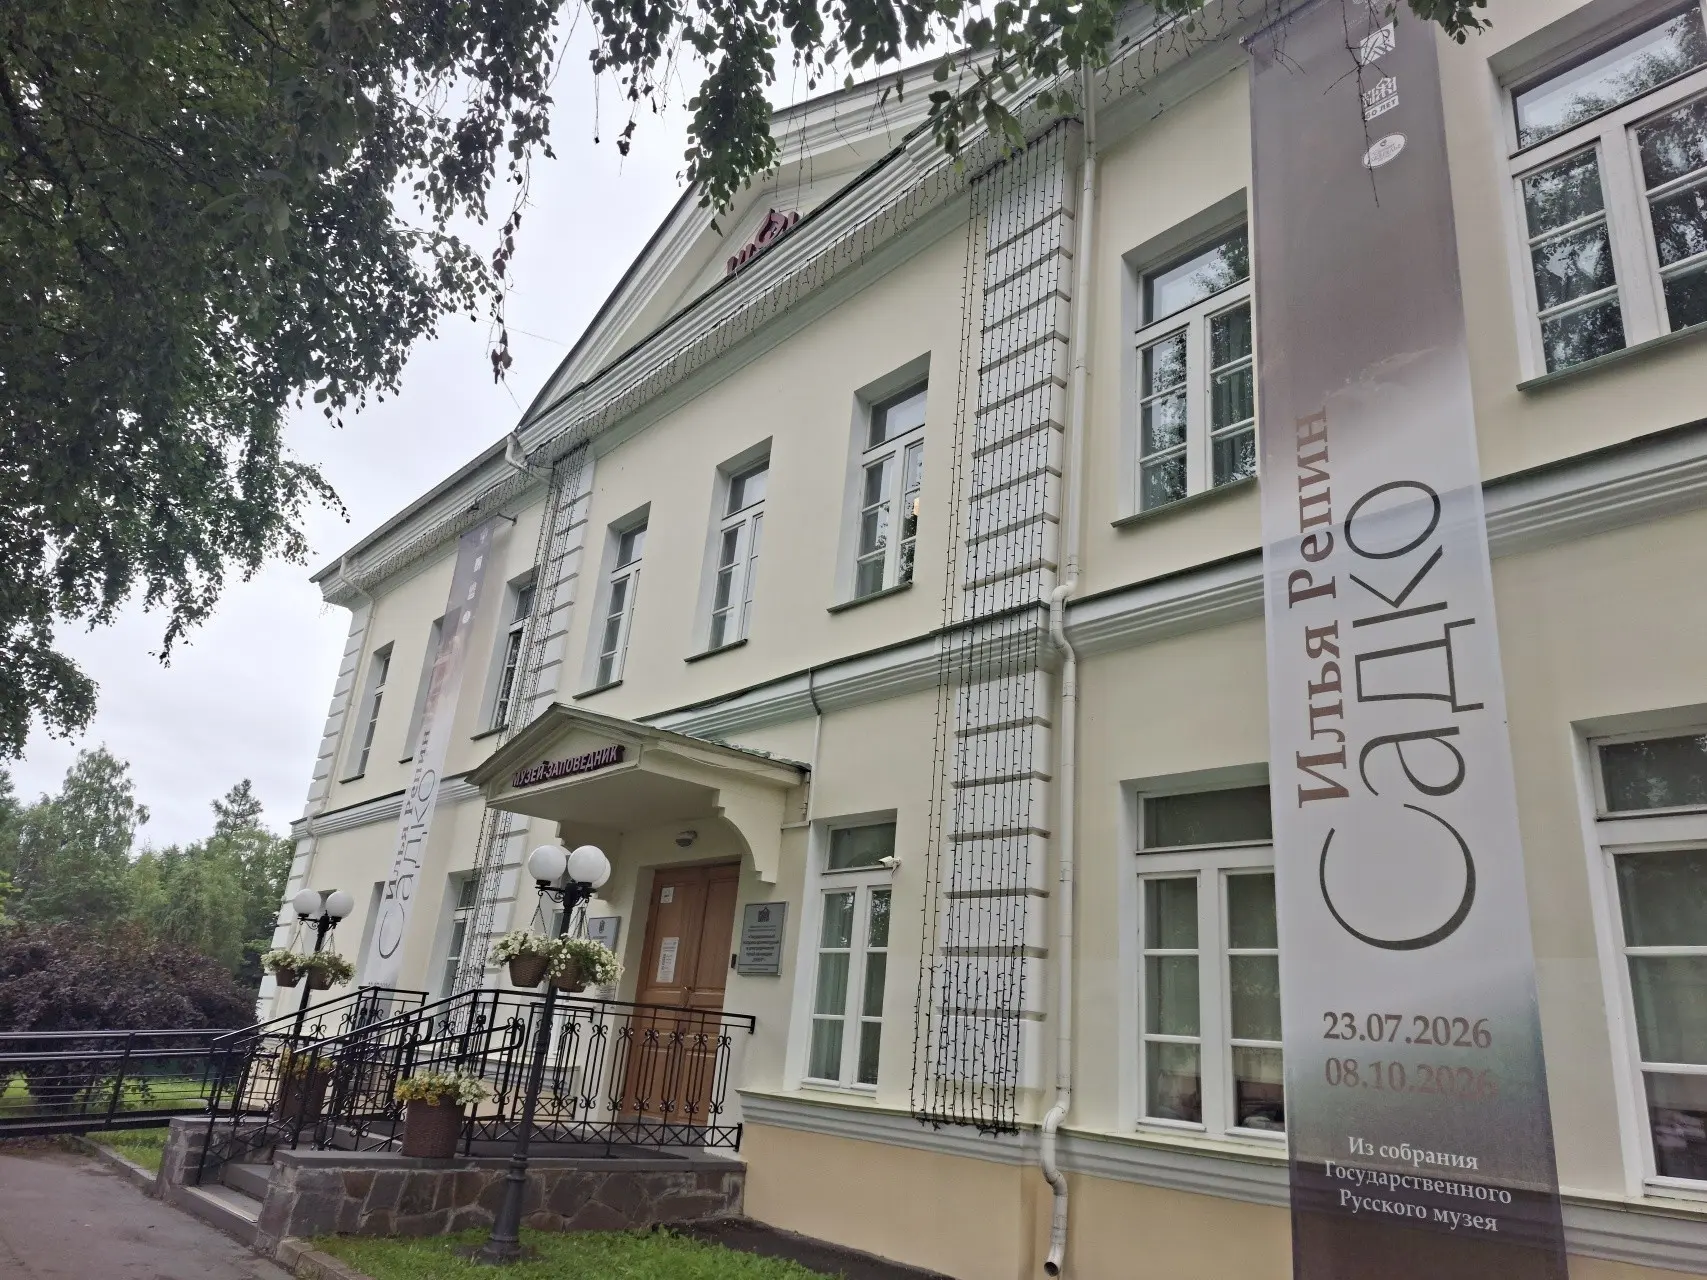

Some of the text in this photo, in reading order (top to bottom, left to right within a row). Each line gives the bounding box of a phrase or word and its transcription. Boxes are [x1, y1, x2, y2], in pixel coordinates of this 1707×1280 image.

[1379, 98, 1397, 113] ЛЕТ
[1287, 404, 1351, 809] Илья Репин
[1319, 479, 1484, 951] Садко
[512, 745, 625, 787] МУЗЕЙ-ЗАПОВЕДНИК
[378, 768, 435, 959] Садко
[1323, 1011, 1493, 1049] 23.07.2026
[1325, 1057, 1499, 1099] 08.10.2026
[1347, 1136, 1479, 1170] Из собрания
[1324, 1160, 1512, 1204] Государственного
[1339, 1188, 1499, 1232] Русского музея
